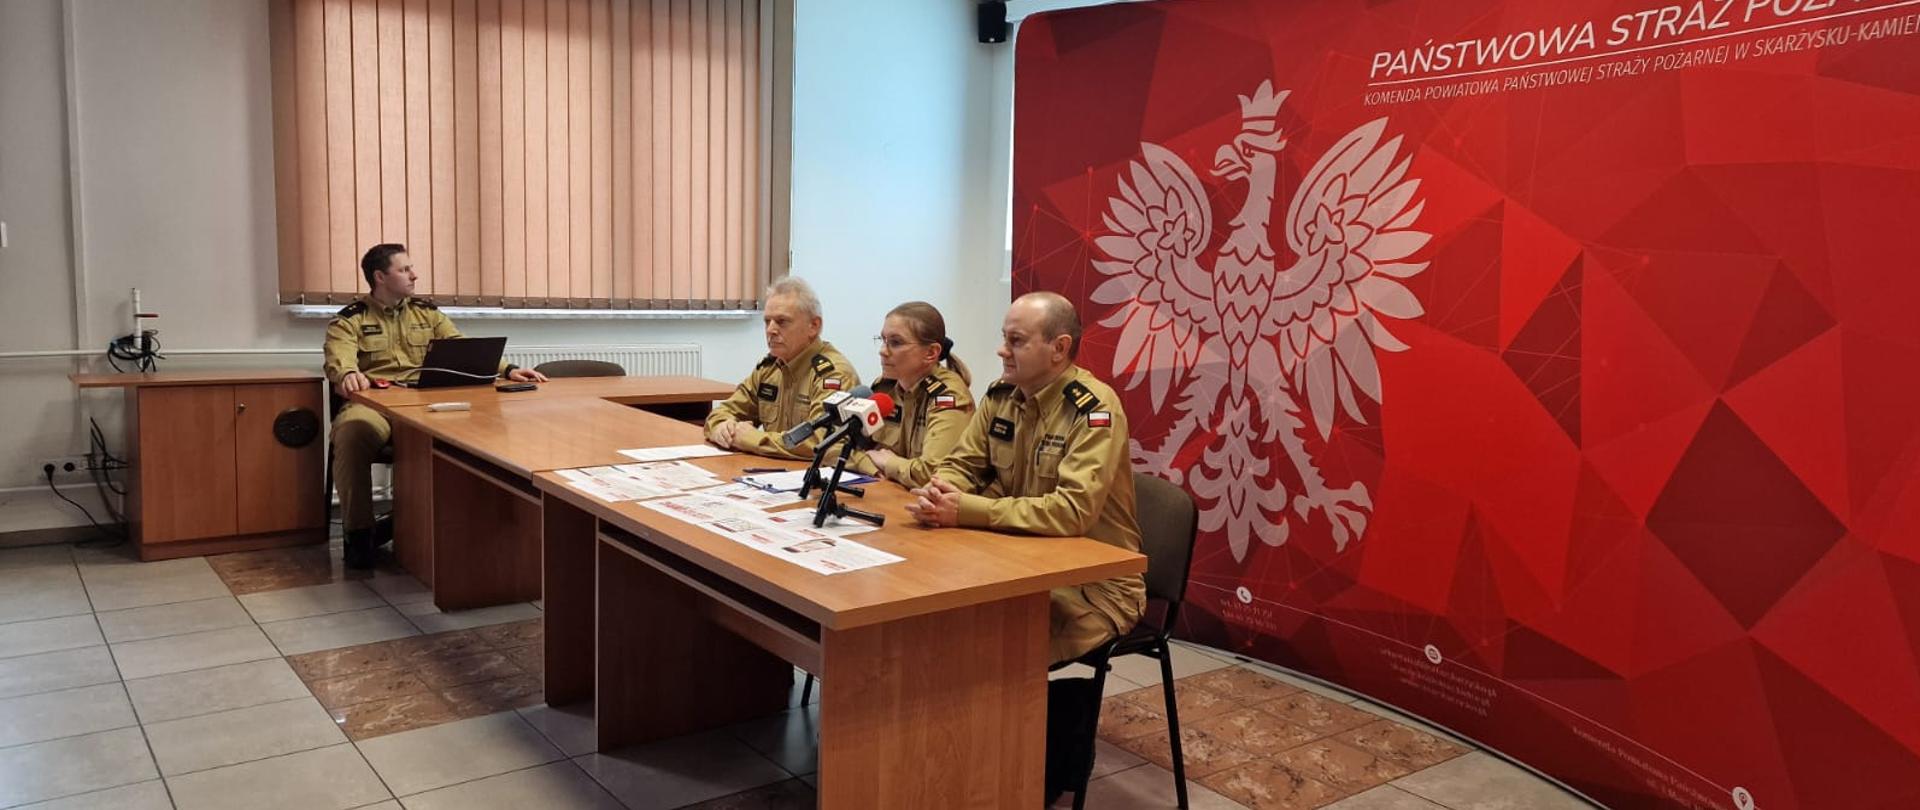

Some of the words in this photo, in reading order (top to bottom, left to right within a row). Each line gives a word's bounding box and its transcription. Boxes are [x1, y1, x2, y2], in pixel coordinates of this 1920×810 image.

[1364, 87, 1420, 106] KOMENDA
[1424, 79, 1499, 100] POWIATOWA
[1503, 66, 1593, 92] PAŃSTWOWEJ
[1597, 56, 1650, 80] STRAŻY
[1654, 45, 1730, 72] POŻARNEJ
[1735, 42, 1750, 59] W
[1370, 21, 1595, 78] PAŃSTWOWA
